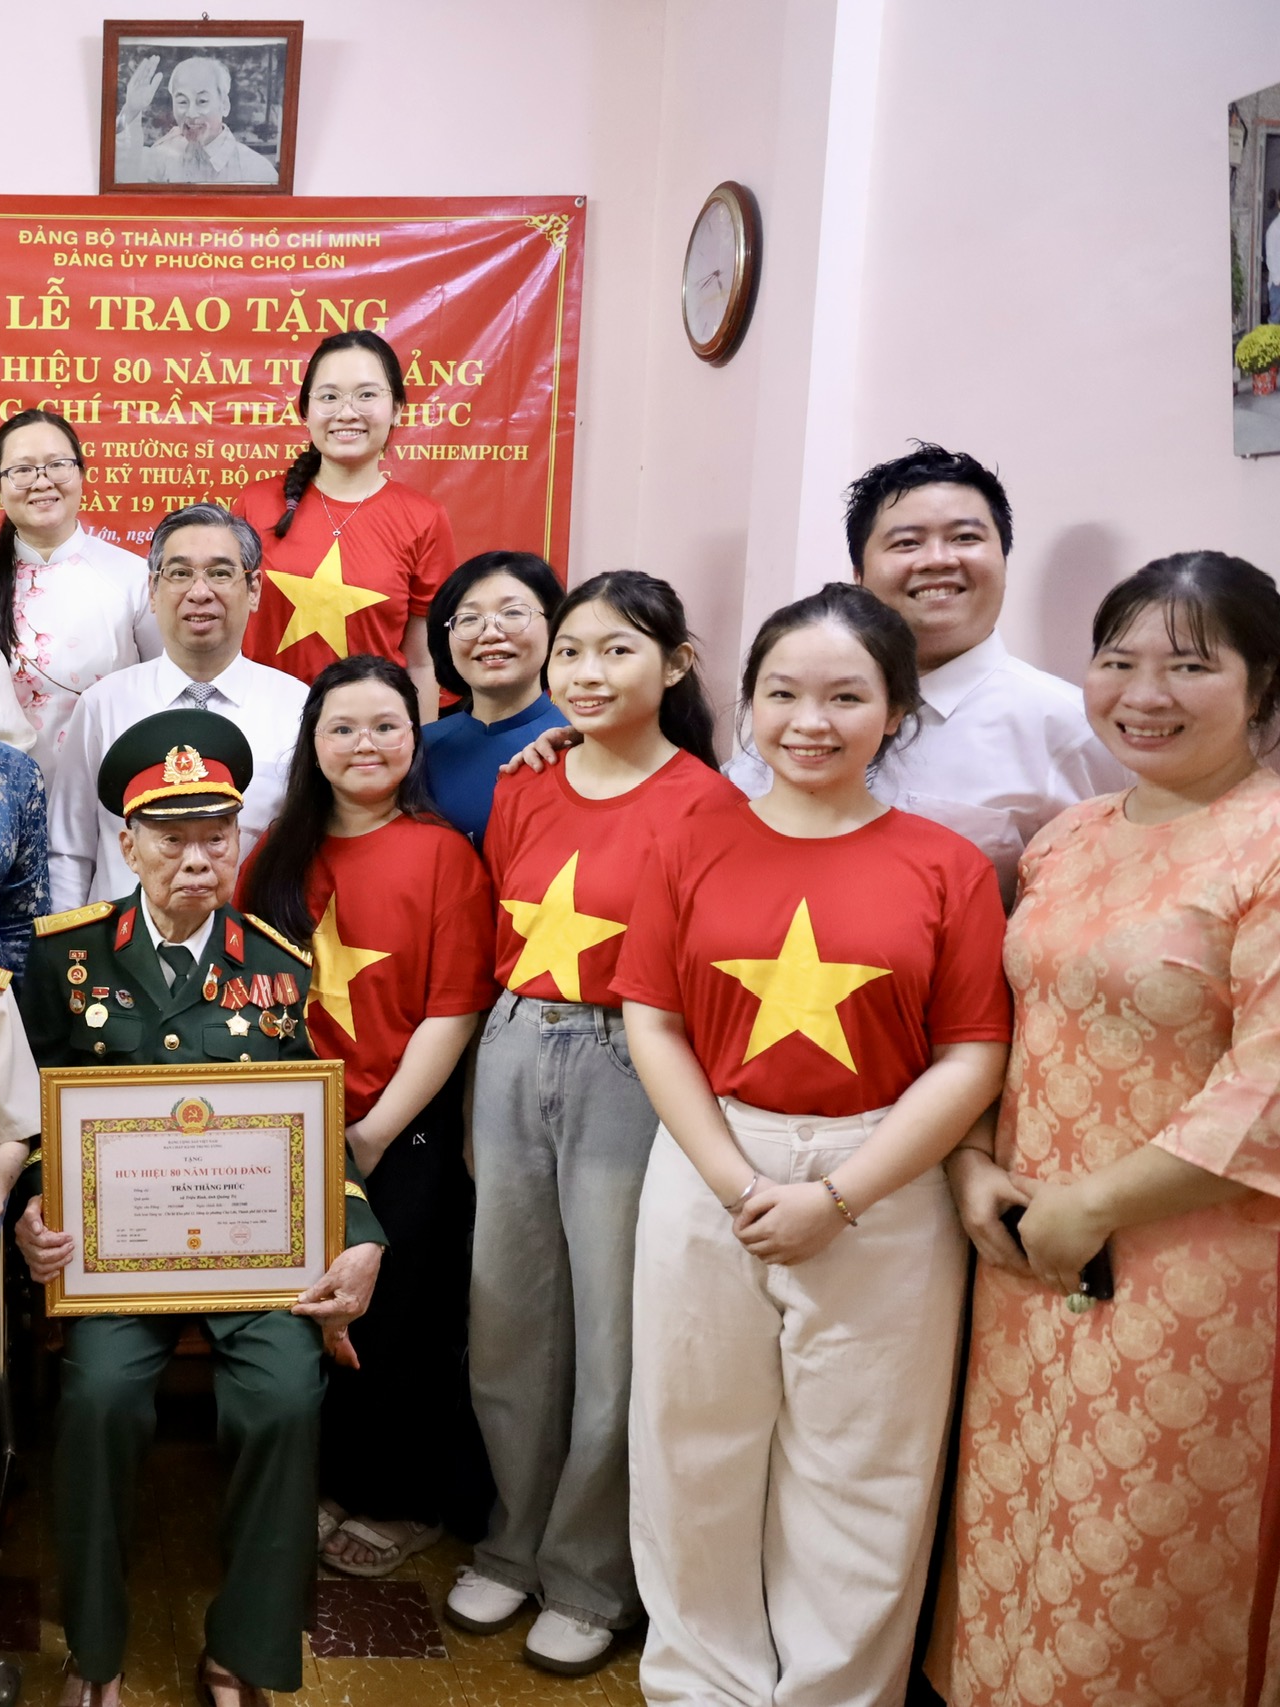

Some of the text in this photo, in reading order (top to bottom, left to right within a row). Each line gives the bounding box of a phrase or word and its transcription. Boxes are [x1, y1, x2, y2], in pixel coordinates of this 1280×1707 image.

[19, 225, 381, 249] ĐẢNG BỘ THÀNH PHỐ HỒ CHÍ MINH
[54, 248, 345, 271] ĐẢNG ỦY PHƯỜNG CHỢ LỚN
[5, 276, 390, 342] LỄ TRAO TẶNG
[0, 349, 101, 389] HIỆU
[112, 357, 152, 384] 80
[163, 351, 253, 385] NĂM
[264, 358, 308, 385] TU
[402, 349, 486, 387] ẢNG
[113, 387, 216, 425] TRẦN
[226, 395, 307, 426] THĂ
[397, 395, 472, 427] HÚC
[101, 439, 189, 459] TRƯỜNG
[194, 439, 215, 459] SĨ
[220, 443, 282, 463] QUAN
[394, 445, 529, 461] VINHEMPICH
[105, 464, 136, 484] KỸ
[139, 465, 215, 487] THUẬT,
[220, 467, 250, 489] BỘ
[78, 490, 123, 513] GÀY
[131, 496, 155, 513] 19
[126, 526, 155, 545] ngà
[115, 1169, 138, 1178] HUY
[141, 1168, 167, 1180] HIỆU
[170, 1169, 181, 1177] 80
[183, 1166, 208, 1177] NĂM
[241, 1164, 271, 1175] ĐẢNG
[223, 1182, 246, 1190] PHÚC
